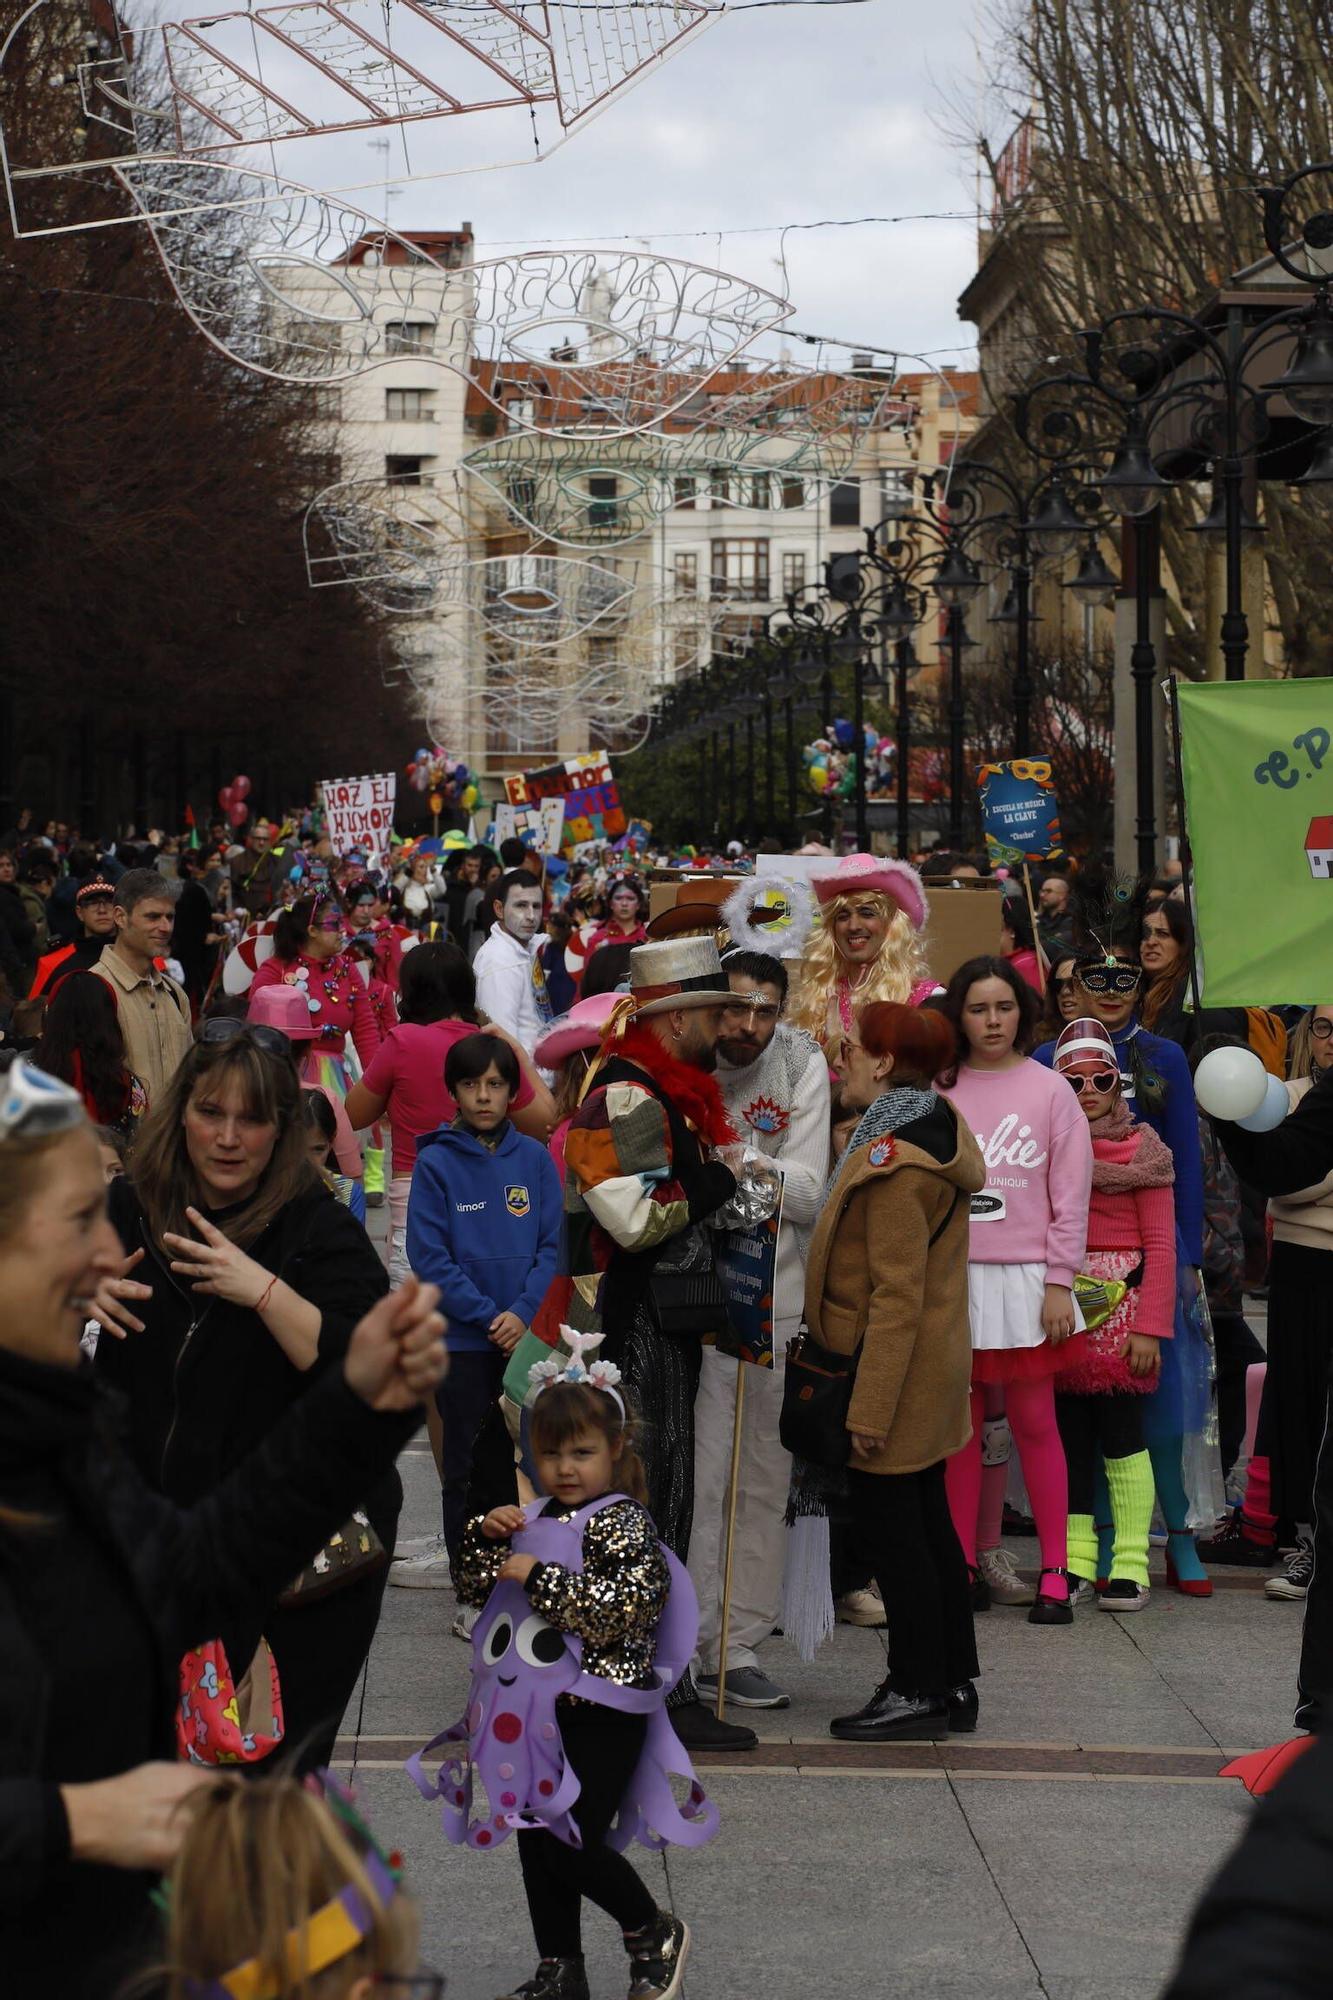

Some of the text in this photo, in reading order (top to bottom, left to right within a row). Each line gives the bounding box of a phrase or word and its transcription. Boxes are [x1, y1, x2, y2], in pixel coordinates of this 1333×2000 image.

[325, 781, 395, 810] HAZ EL
[992, 803, 1016, 814] ESCUELA
[1016, 802, 1024, 810] DE
[333, 807, 392, 833] HUMOR
[1004, 810, 1037, 824] LA CLAVE
[989, 1176, 1029, 1188] UNIQUE
